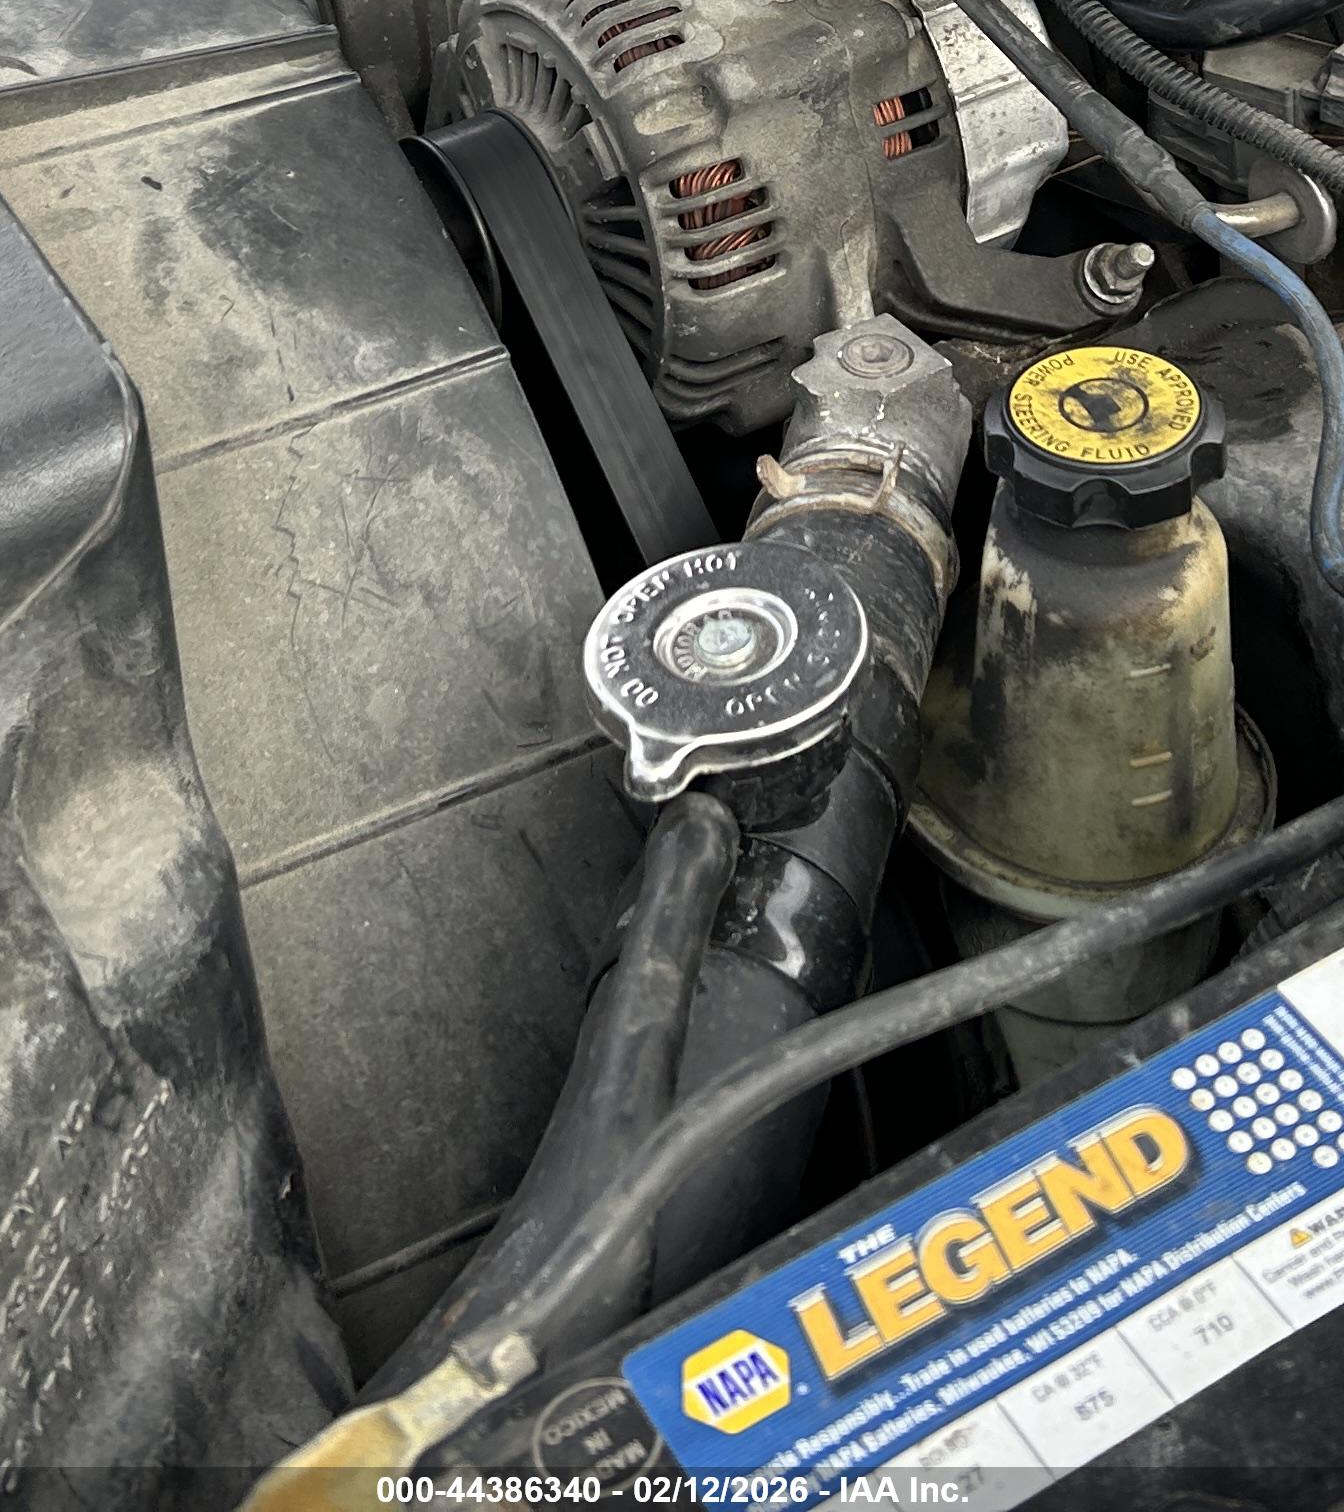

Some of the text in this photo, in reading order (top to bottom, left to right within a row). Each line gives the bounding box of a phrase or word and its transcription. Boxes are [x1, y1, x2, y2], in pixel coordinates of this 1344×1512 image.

[1014, 353, 1150, 460] POWER STEERING FLUID
[1113, 350, 1194, 431] USE APPROVED
[781, 1089, 1206, 1381] LEGEND
[837, 1222, 897, 1266] THE
[810, 1437, 868, 1483] NAPA
[935, 1340, 1034, 1408] Milwaukee,
[1022, 1326, 1056, 1357] WI
[1097, 1284, 1126, 1312] for
[1118, 1257, 1170, 1298] NAPA
[1161, 1209, 1252, 1272] Distribution
[1243, 1175, 1310, 1225] Centers
[946, 1344, 969, 1369] in
[962, 1321, 1008, 1359] used
[999, 1281, 1075, 1336] batteries
[1066, 1272, 1091, 1298] to
[1082, 1242, 1140, 1286] NAPA.
[695, 1348, 781, 1418] NAPA
